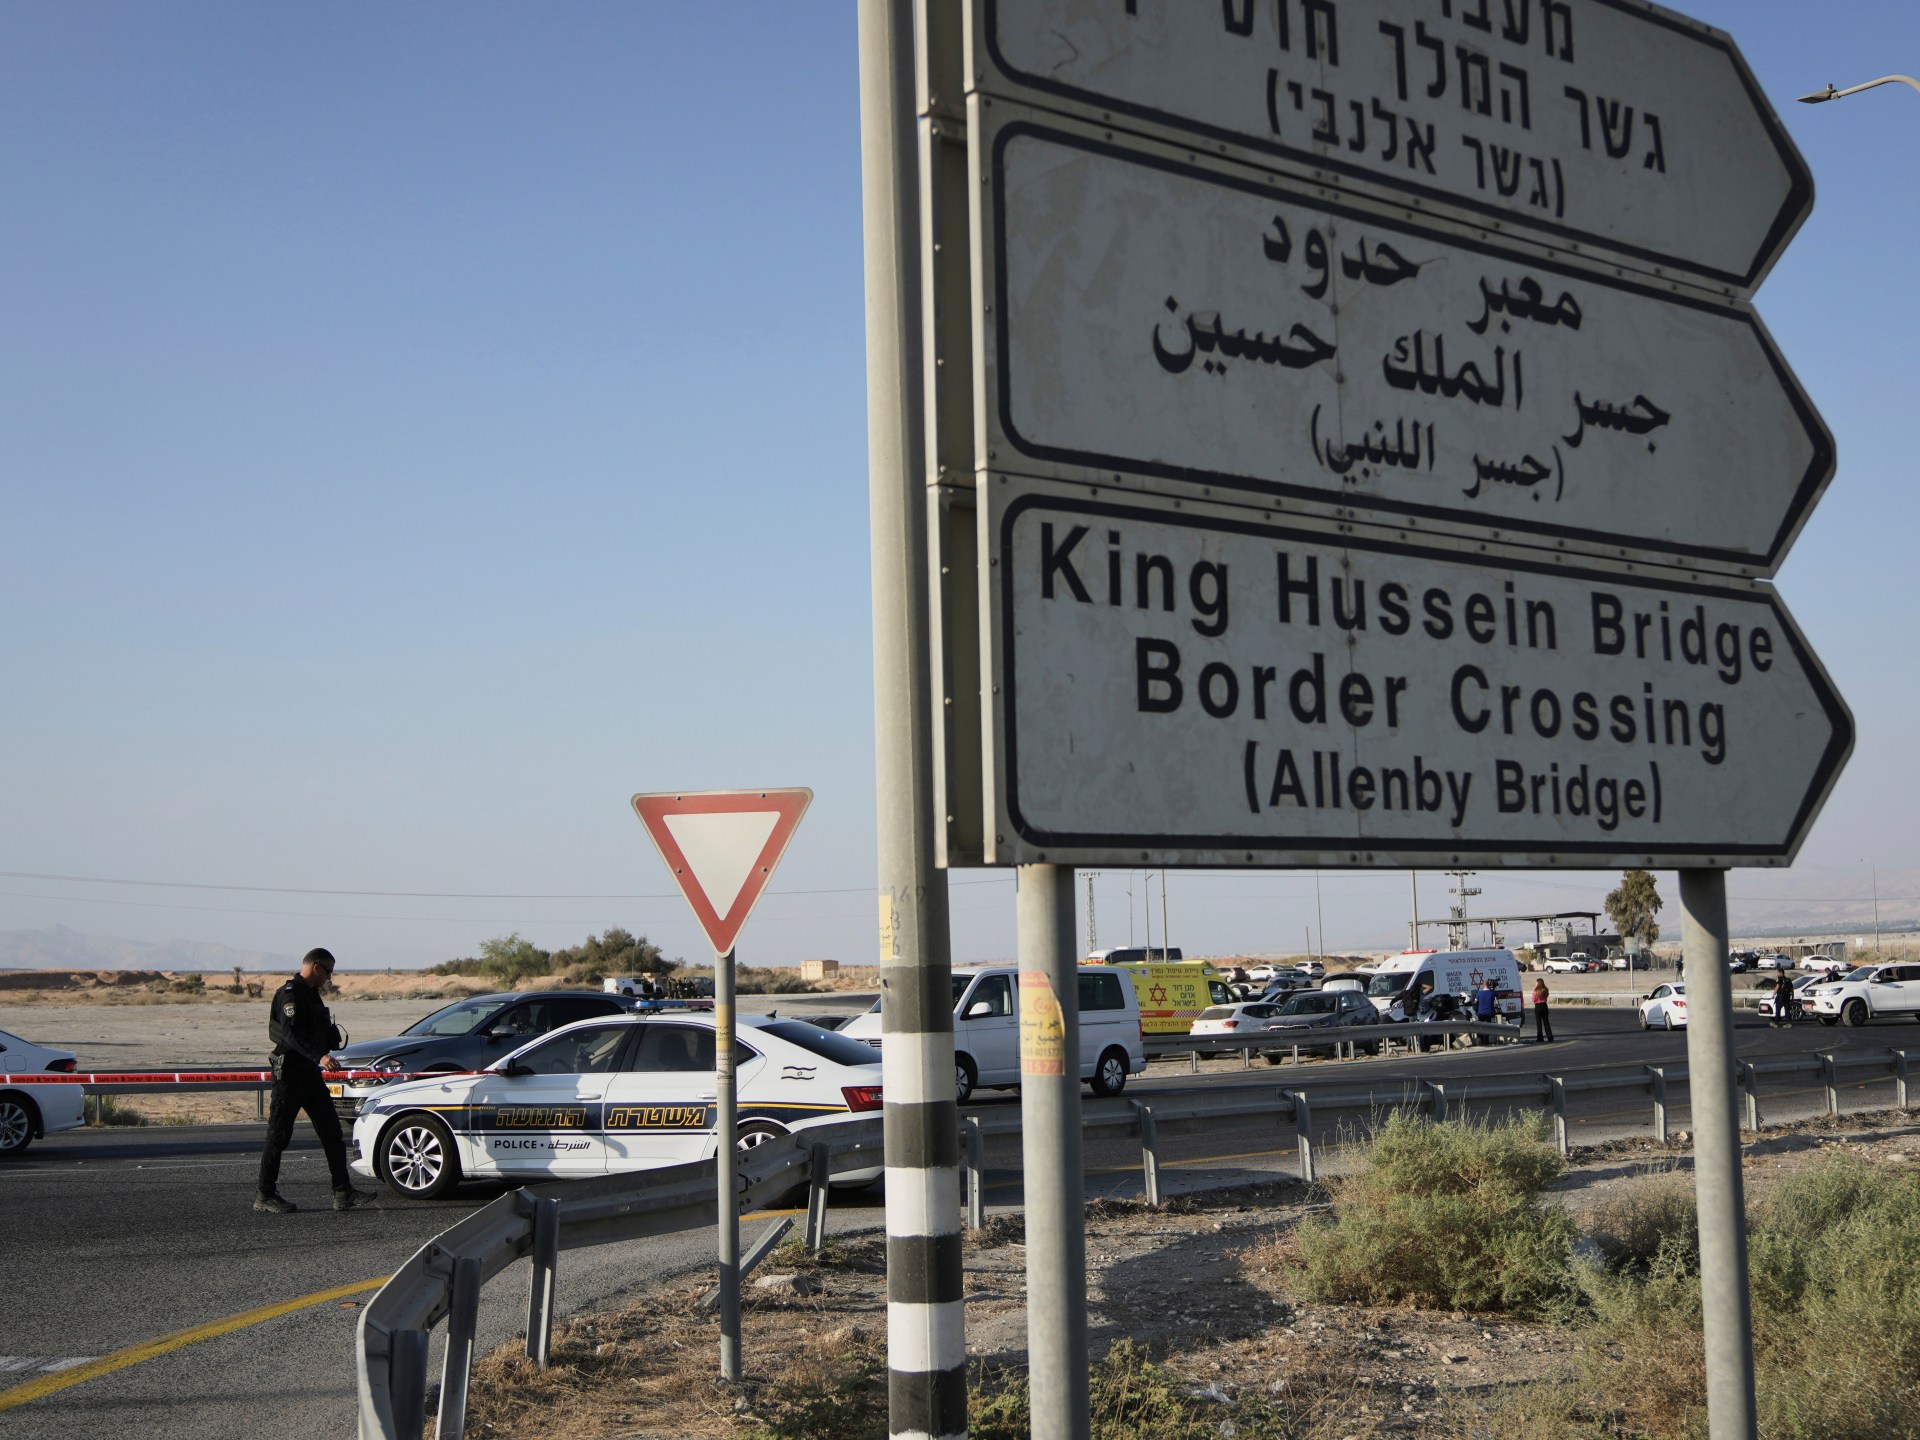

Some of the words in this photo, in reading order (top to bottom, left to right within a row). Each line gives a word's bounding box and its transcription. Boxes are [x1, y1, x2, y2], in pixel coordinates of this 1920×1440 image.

[1441, 0, 1575, 64] מעב
[1378, 20, 1531, 131] המלך
[1266, 68, 1437, 175] אלנבי)
[1563, 85, 1666, 174] גשר
[1462, 134, 1565, 219] (גשר
[1262, 215, 1421, 300] حدود
[1152, 296, 1338, 375] حسين
[1466, 276, 1583, 335] معبر
[1382, 329, 1523, 411] الملك
[1310, 404, 1435, 484] اللنبي)
[1562, 390, 1671, 452] جسر
[1462, 446, 1564, 502] (جسر
[1039, 521, 1229, 638] King
[1276, 551, 1557, 650] Hussein
[1590, 591, 1773, 685] Bridge
[1135, 636, 1407, 728] Border
[1450, 664, 1726, 766] Crossing
[1244, 740, 1472, 828] (Allenby
[1495, 759, 1662, 832] Bridge)
[1172, 999, 1196, 1007] בישראל
[494, 1140, 538, 1150] POLICE
[495, 1107, 587, 1127] התנועה
[547, 1139, 592, 1151] الشرطة
[607, 1107, 707, 1127] משטרת
